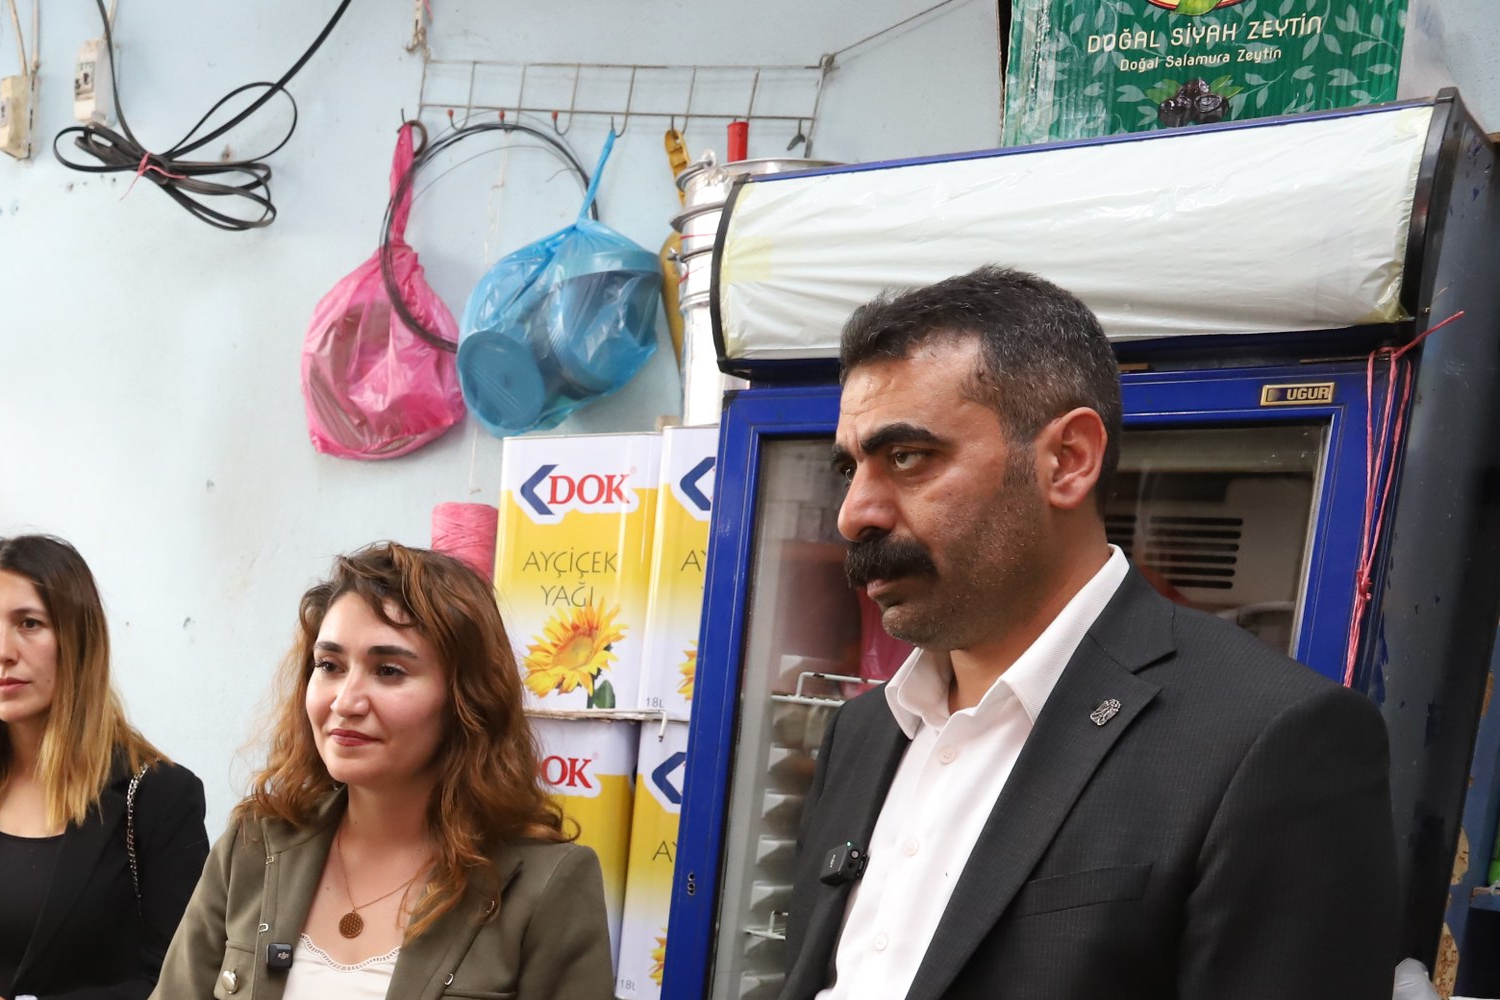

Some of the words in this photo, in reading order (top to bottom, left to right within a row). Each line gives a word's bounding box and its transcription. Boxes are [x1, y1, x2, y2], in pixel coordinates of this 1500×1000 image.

[1087, 29, 1161, 53] DOĞAL
[1170, 22, 1237, 45] SİYAH
[1247, 13, 1323, 40] ZEYTİN
[1120, 57, 1159, 73] Doğal
[1165, 51, 1230, 67] Salamura
[1237, 46, 1282, 64] Zeytin
[547, 474, 630, 504] DOK
[522, 547, 618, 579] AYÇİÇEK
[540, 581, 594, 608] YAĞI
[647, 696, 664, 708] 18L
[533, 755, 592, 789] OK
[620, 979, 637, 991] 18L
